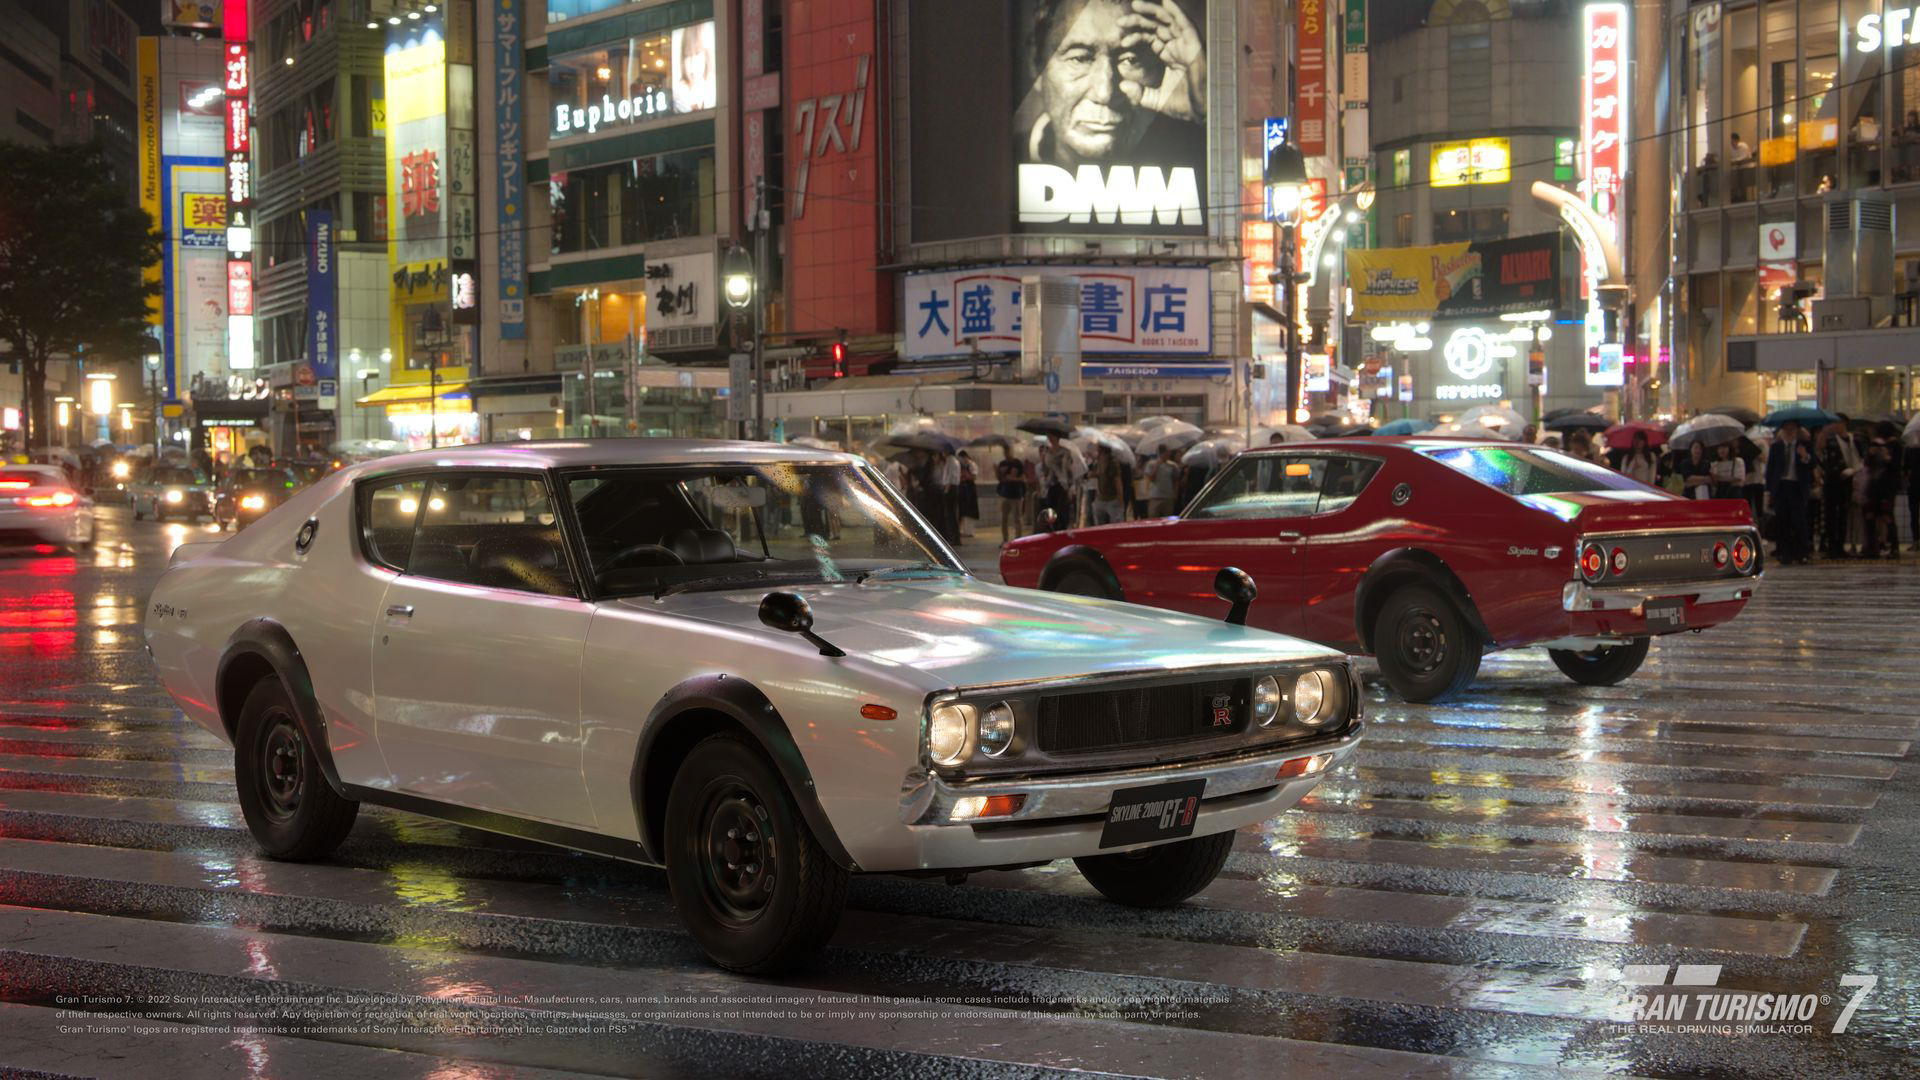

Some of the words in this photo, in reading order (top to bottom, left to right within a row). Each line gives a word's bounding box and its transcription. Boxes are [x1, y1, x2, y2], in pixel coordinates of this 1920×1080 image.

[497, 14, 520, 199] サマーフルーツギフト
[556, 87, 668, 133] Euphoria
[793, 54, 871, 220] クスリ
[145, 125, 156, 201] Matsumoto
[400, 148, 441, 217] 薬
[192, 196, 226, 227] 薬
[1018, 164, 1203, 225] DMM
[317, 223, 329, 274] MIZUHO
[918, 282, 1187, 338] 大盛書店
[1142, 338, 1165, 347] BOOKS
[1167, 338, 1199, 347] TAISEIDO
[1106, 367, 1159, 375] TAISEIDO
[1213, 708, 1232, 726] R
[1110, 804, 1144, 823] SKYLINE
